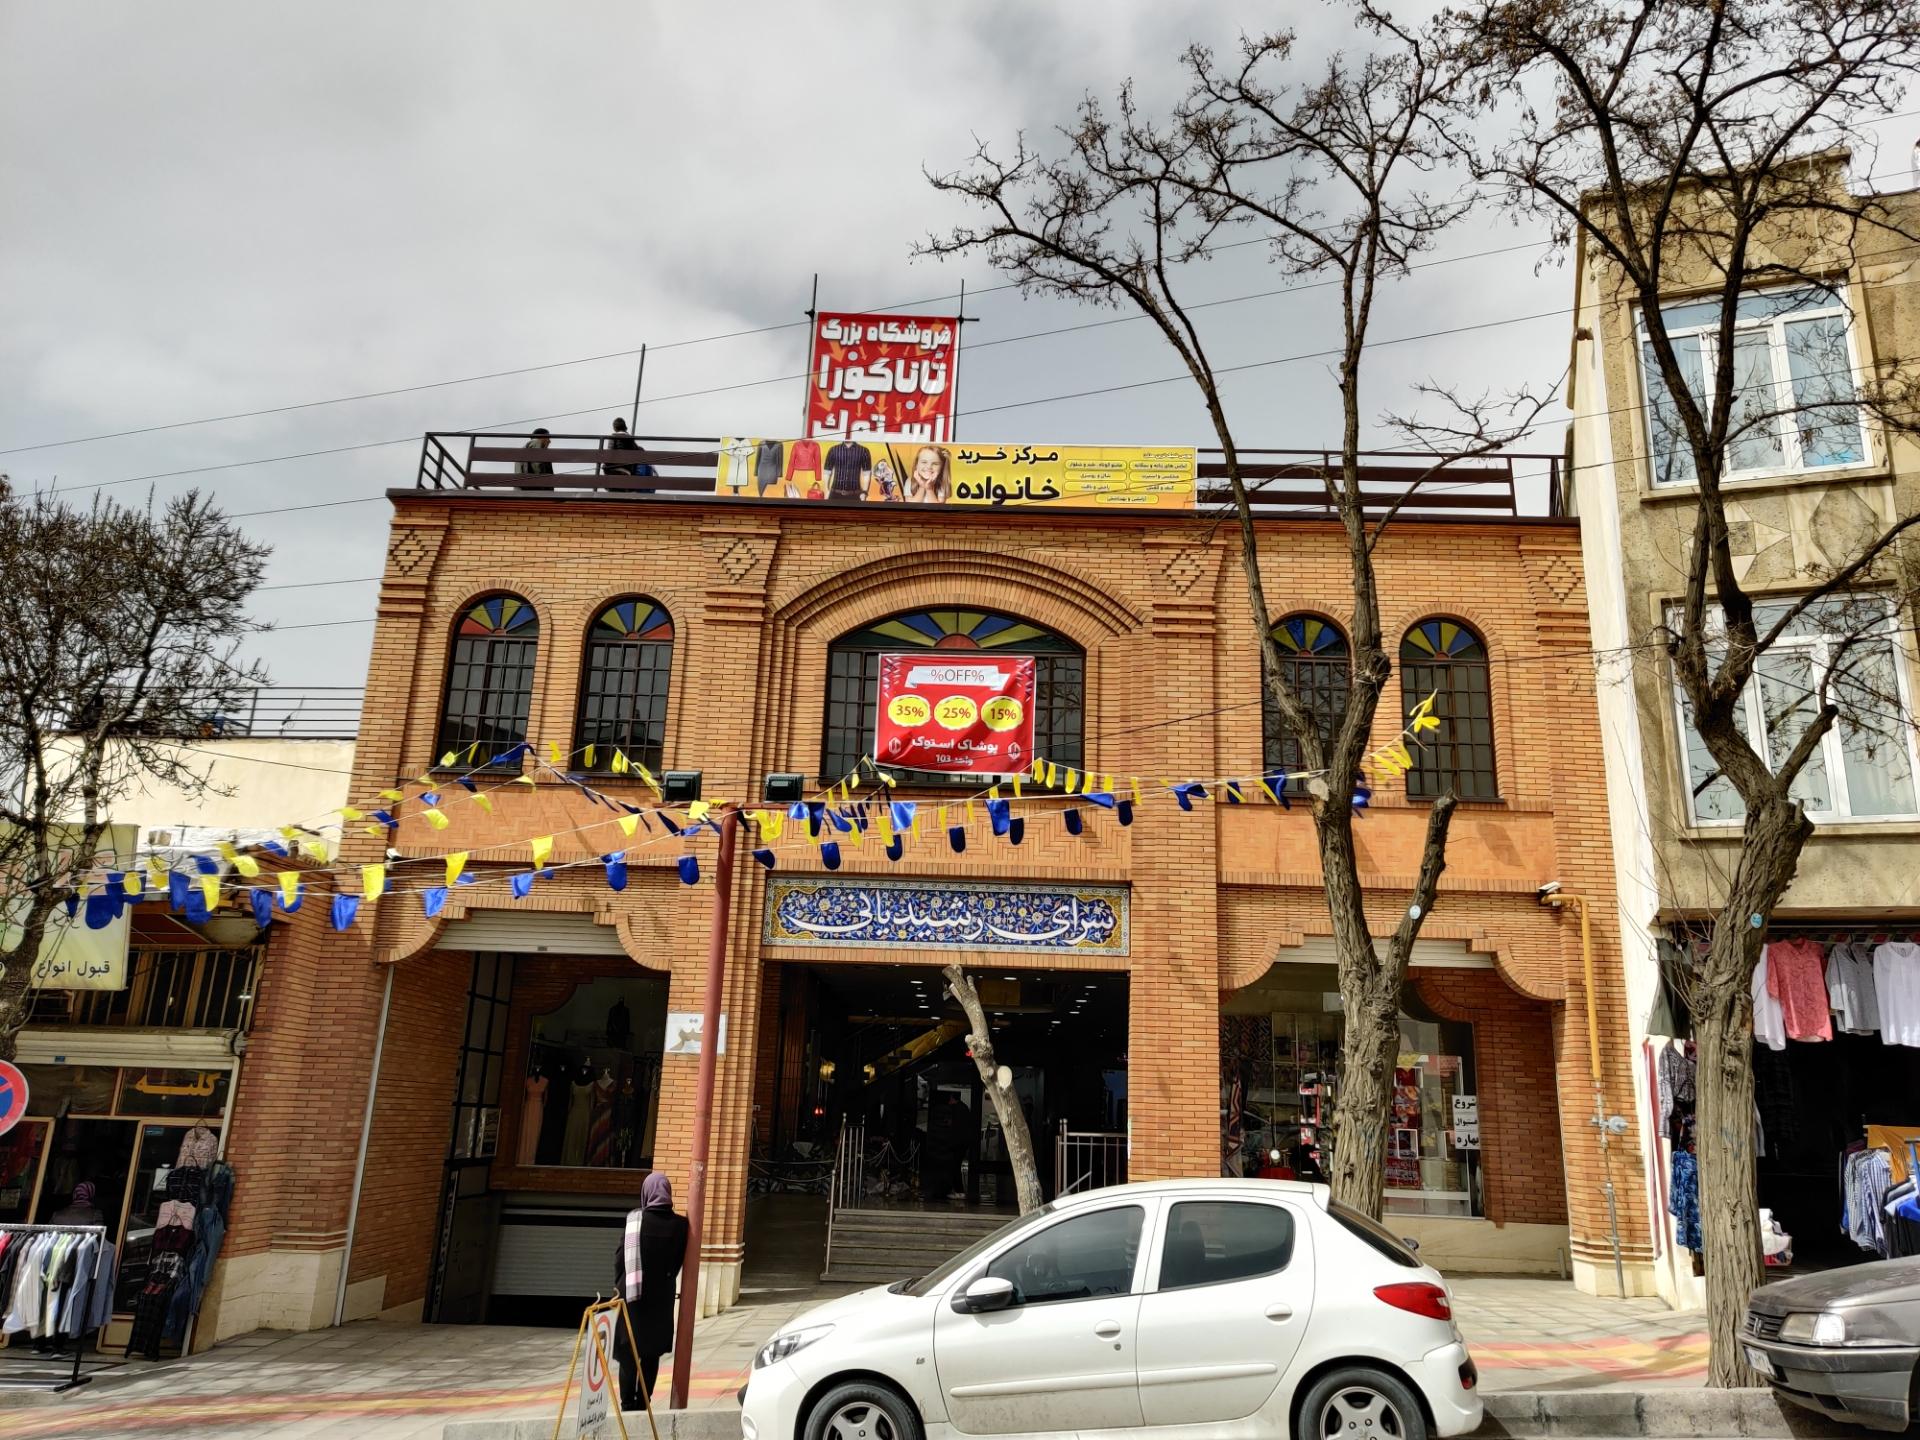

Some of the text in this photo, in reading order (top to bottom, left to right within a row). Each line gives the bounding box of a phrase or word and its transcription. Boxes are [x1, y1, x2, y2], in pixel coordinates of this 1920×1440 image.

[821, 319, 951, 350] فروشگاه بزرگ
[819, 353, 947, 401] تاناکورا
[957, 446, 1059, 465] مرکز خرید
[956, 475, 1060, 506] خانواده
[930, 668, 985, 683] %OFF%
[896, 704, 1017, 720] 35% 25% 15%
[911, 736, 999, 755] پوشاک استوک
[935, 754, 951, 764] 103
[985, 896, 1114, 945] سرای
[37, 960, 110, 978] قبول انواع
[1454, 1098, 1476, 1109] شروع
